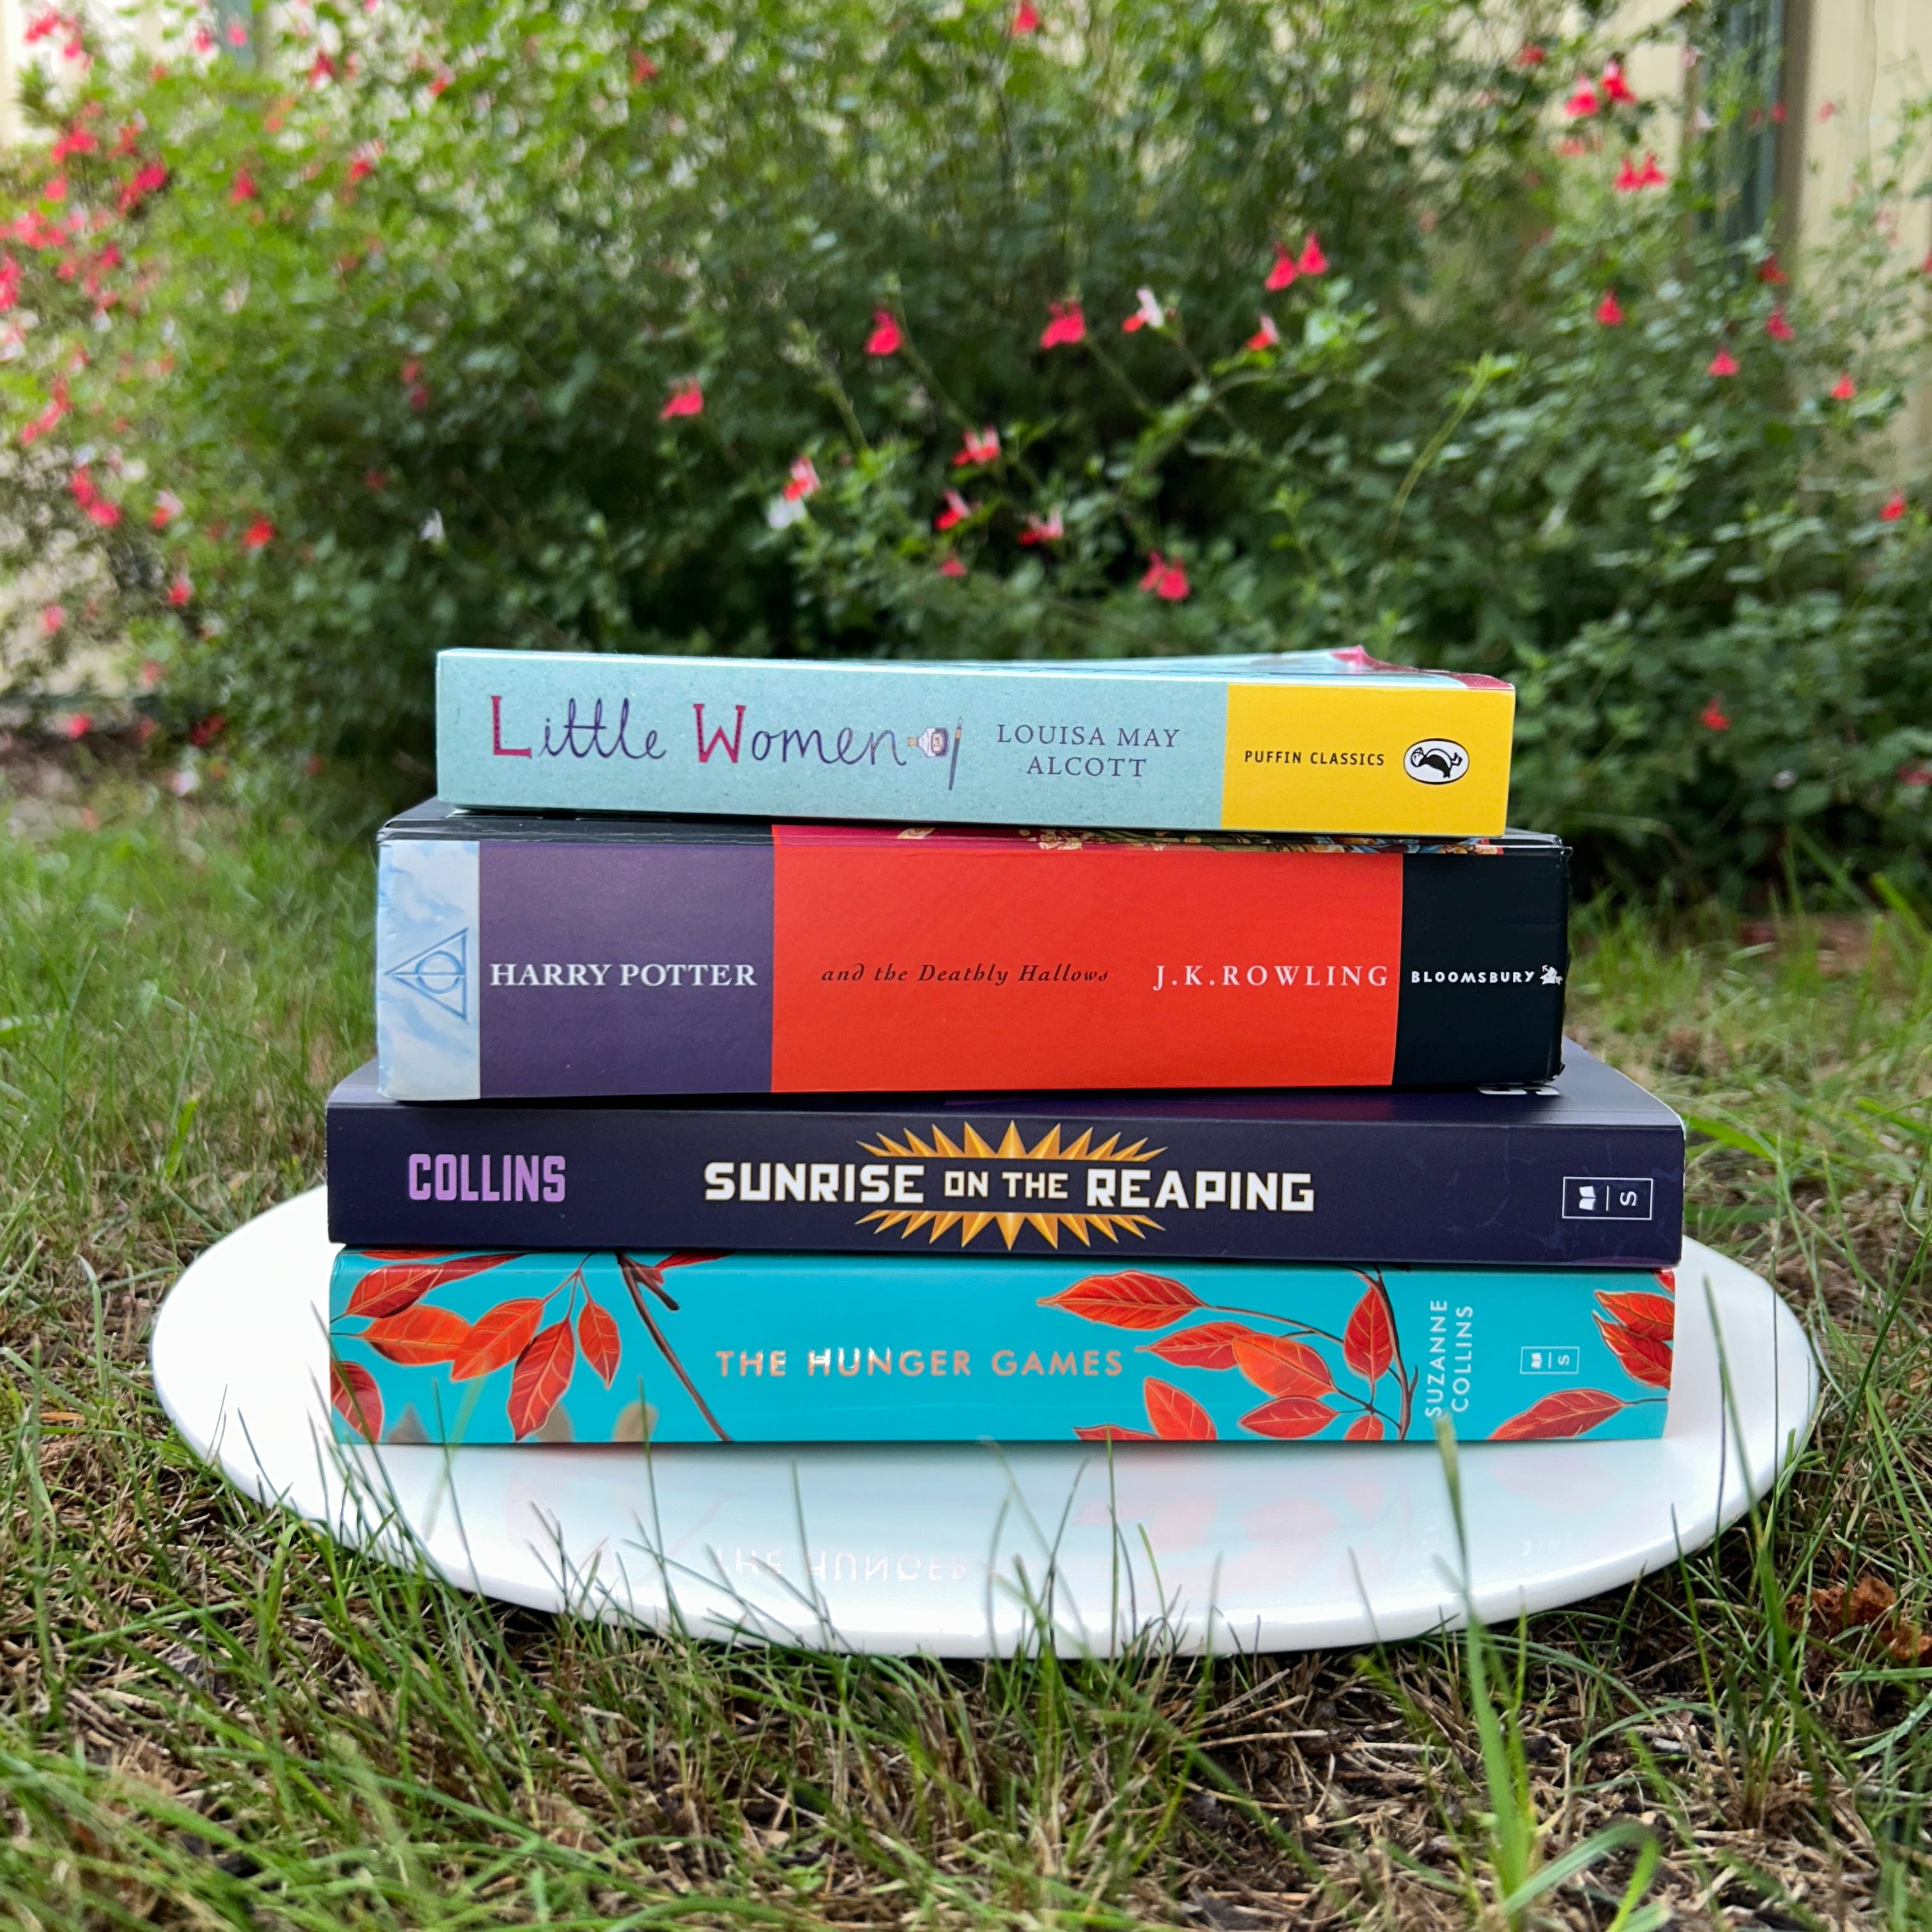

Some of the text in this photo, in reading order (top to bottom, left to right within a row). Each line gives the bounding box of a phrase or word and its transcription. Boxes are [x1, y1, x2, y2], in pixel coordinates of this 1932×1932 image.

[490, 695, 907, 766] Little Women
[997, 723, 1181, 748] LOUISA MAY
[1026, 755, 1147, 778] ALCOTT
[1244, 749, 1385, 767] PUFFIN CLASSICS
[489, 963, 758, 987] HARRY POTTER
[821, 963, 1108, 986] and the Deathly Hallows
[1411, 970, 1535, 984] BLOOMSBURY
[408, 1153, 566, 1202] COLLINS
[704, 1162, 1315, 1213] SUNRISE ON THE REAPING
[1620, 1190, 1637, 1207] S
[715, 1346, 1123, 1377] THE HUNGER GAMES
[1425, 1300, 1448, 1418] SUZANNE
[1451, 1305, 1474, 1413] COLLINS
[1557, 1354, 1571, 1367] S
